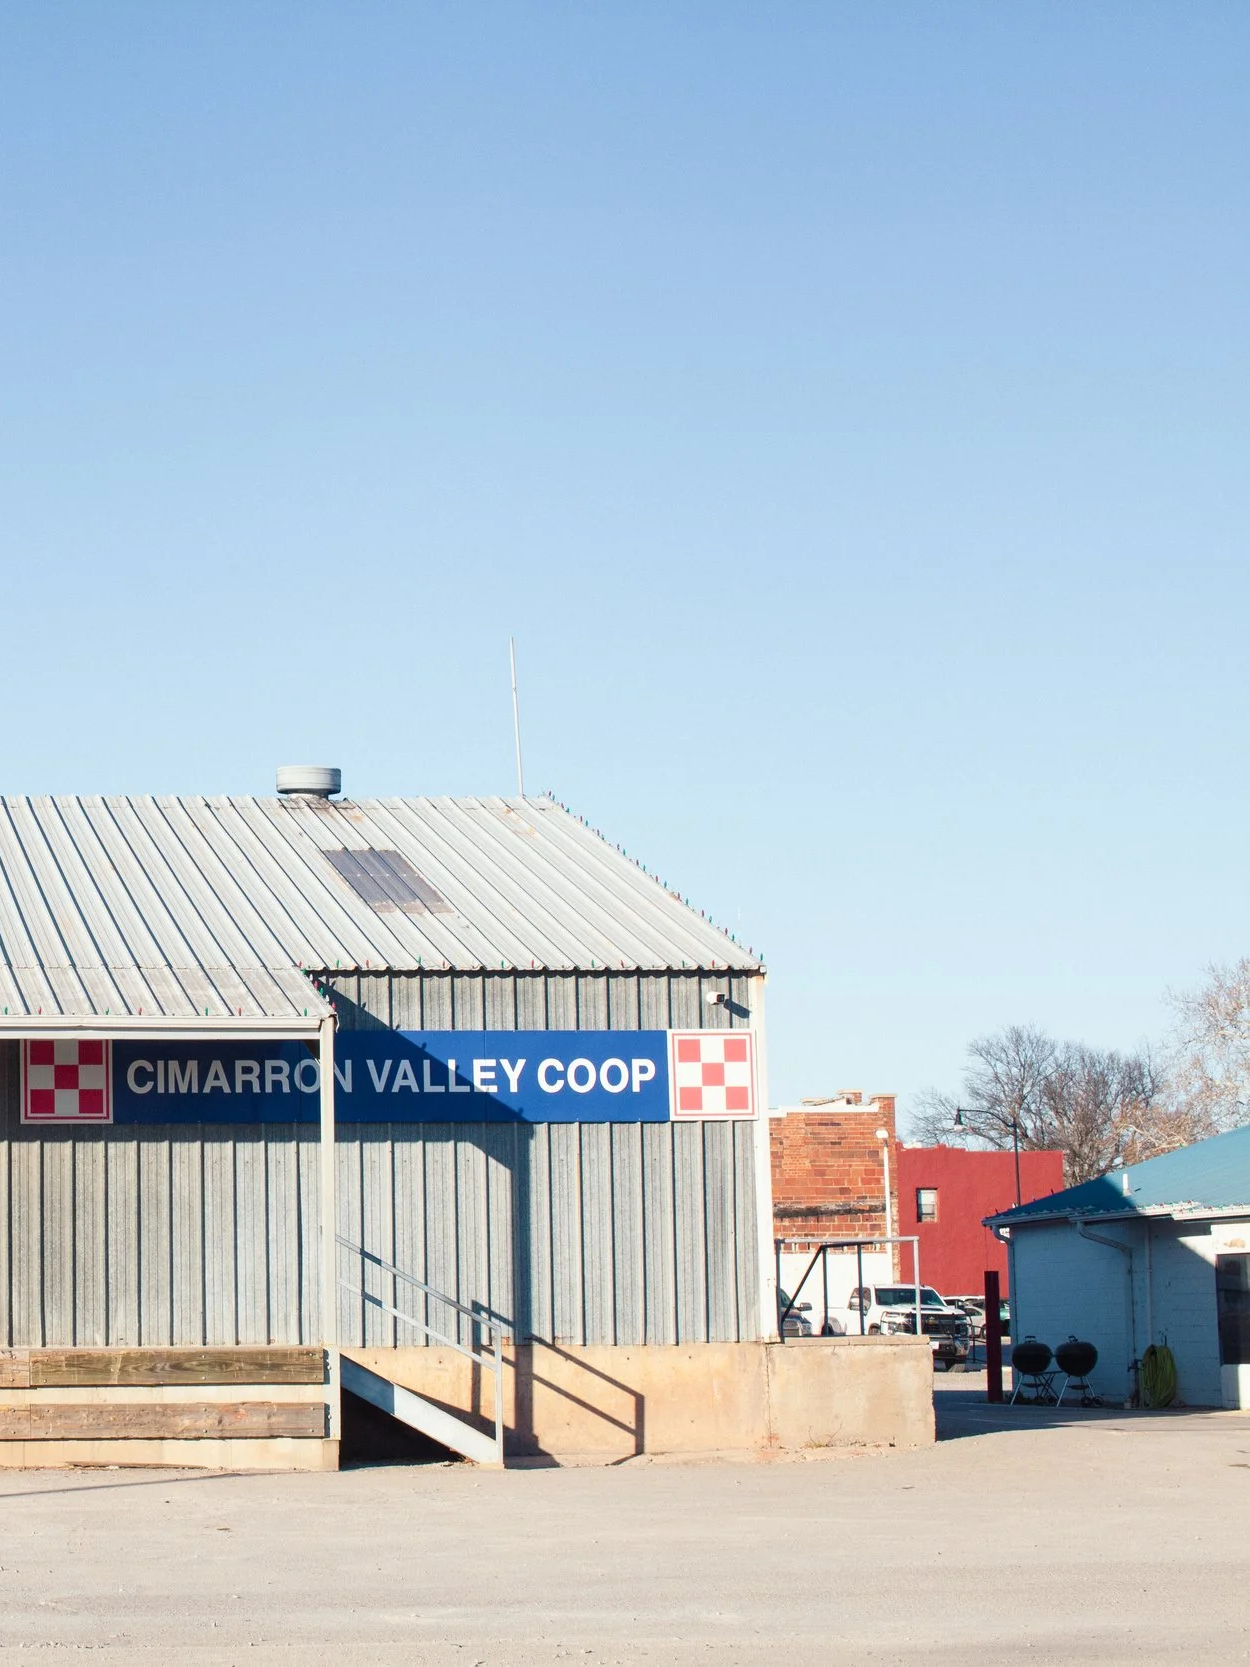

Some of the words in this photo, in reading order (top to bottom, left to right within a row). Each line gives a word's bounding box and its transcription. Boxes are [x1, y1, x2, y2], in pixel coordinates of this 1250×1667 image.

[127, 1059, 352, 1094] CIMARRON
[366, 1059, 527, 1093] VALLEY
[537, 1058, 656, 1093] COOP
